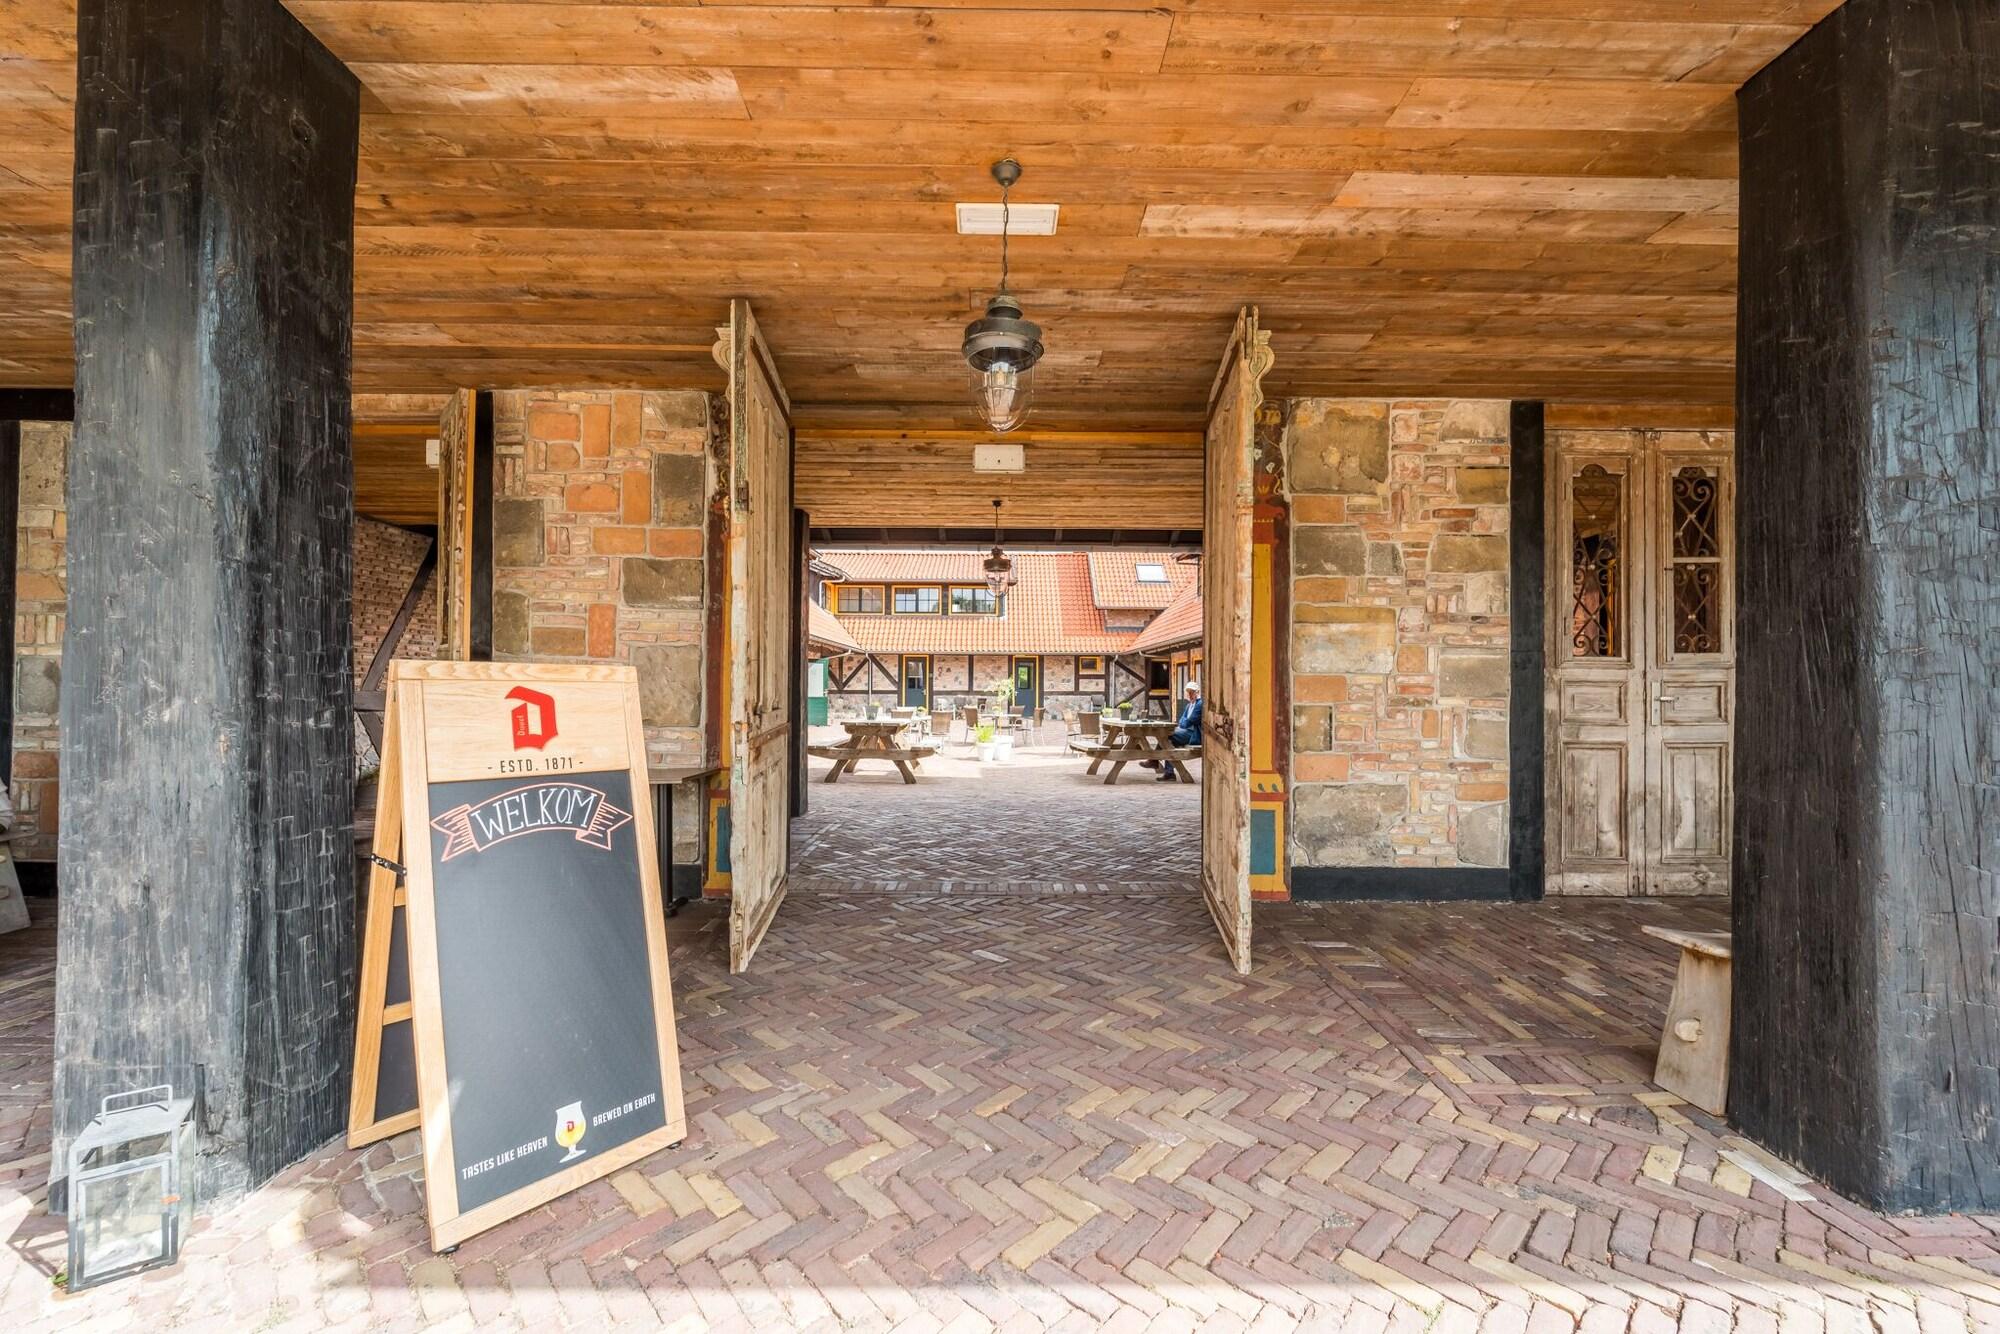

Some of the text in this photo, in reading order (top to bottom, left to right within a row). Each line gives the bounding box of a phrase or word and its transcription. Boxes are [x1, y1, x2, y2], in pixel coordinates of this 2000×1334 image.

[500, 757, 573, 773] ESTD. 1871
[471, 787, 598, 841] WELKOM
[592, 1093, 656, 1127] BREWED ON EARTH
[462, 1136, 548, 1180] TASTES LIKE HEAVEN
